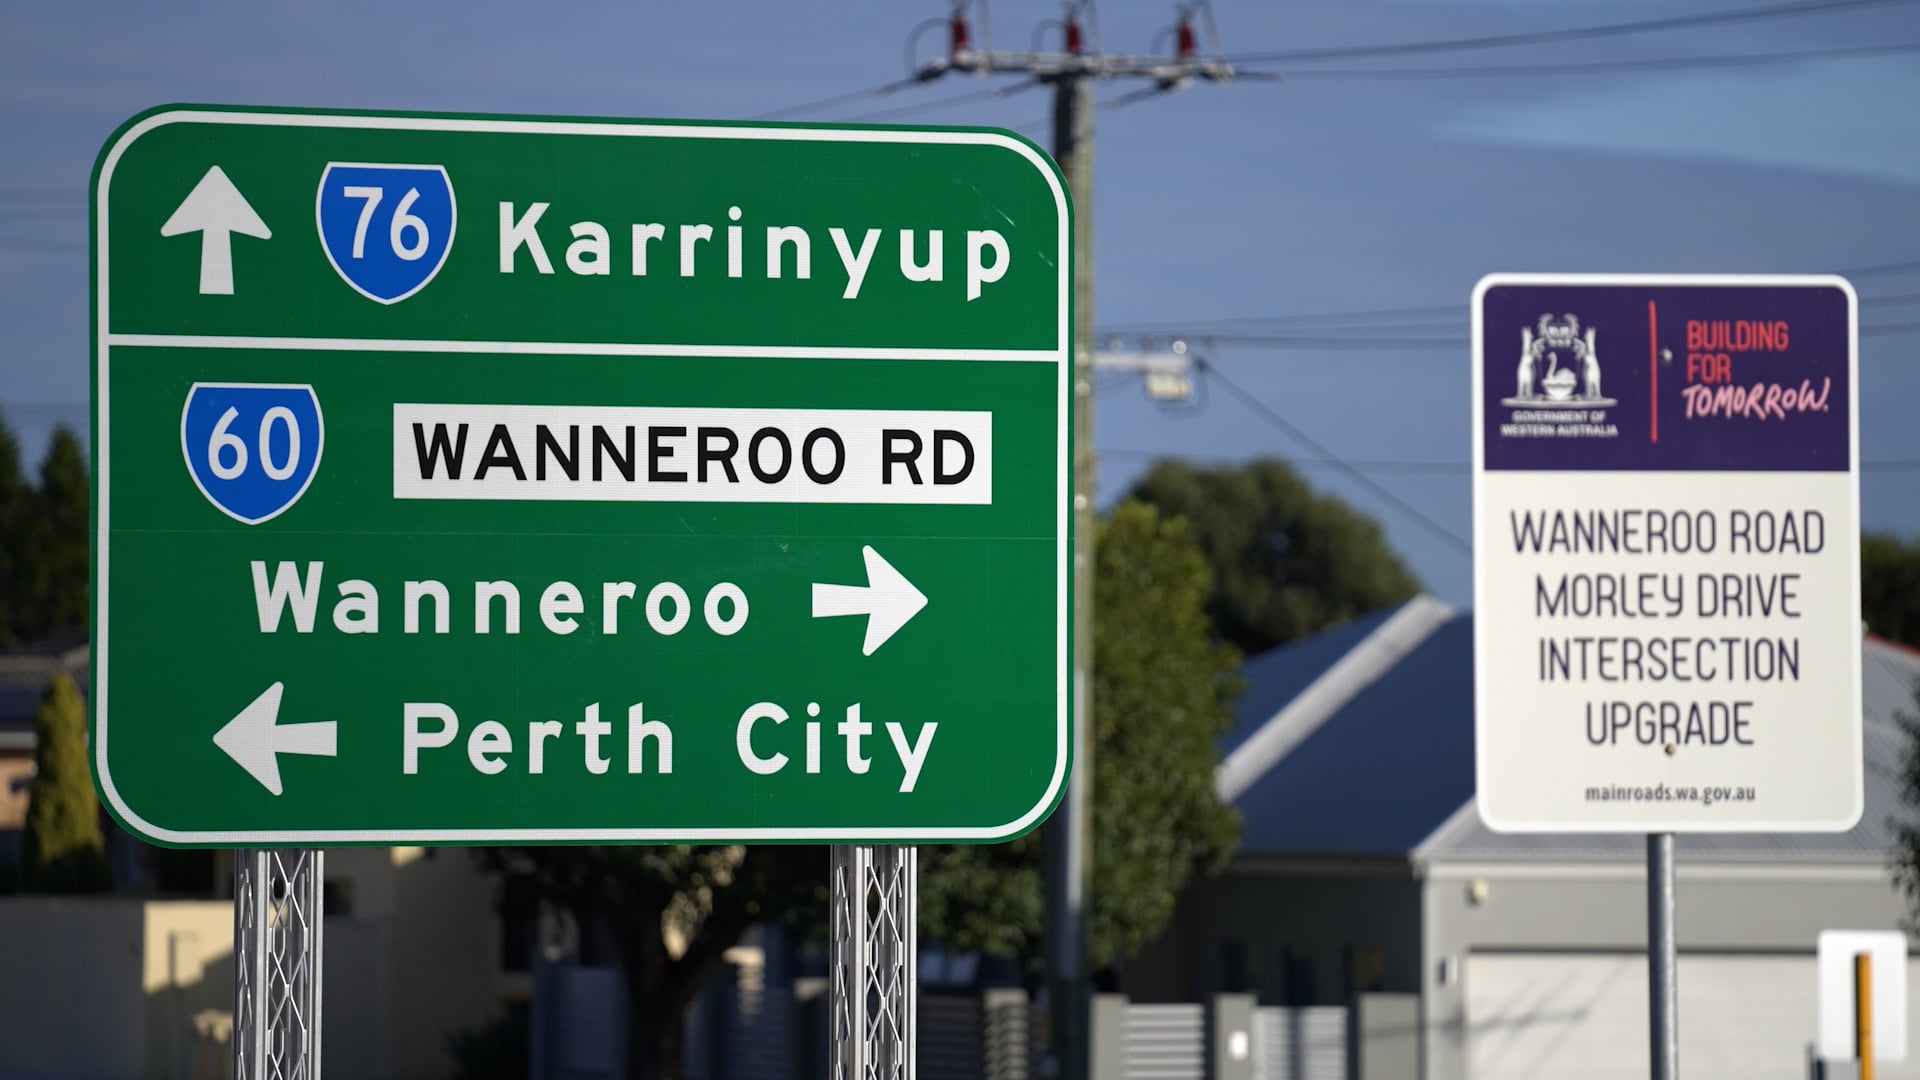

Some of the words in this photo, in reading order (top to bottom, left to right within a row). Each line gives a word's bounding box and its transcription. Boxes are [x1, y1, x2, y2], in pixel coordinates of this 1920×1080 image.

[343, 186, 430, 261] 76
[500, 202, 1012, 301] Karrinyup
[1687, 320, 1789, 351] BUILDING
[1687, 353, 1731, 383] FOR
[1500, 424, 1556, 438] WESTERN
[1557, 424, 1619, 438] AUSTRALIA
[1512, 410, 1588, 423] GOVERNMENT
[1590, 410, 1606, 423] OF
[207, 406, 301, 481] 60
[412, 423, 845, 484] WANNEROO
[882, 429, 974, 485] RD
[1511, 510, 1716, 554] WANNEROO
[1730, 510, 1825, 554] ROAD
[251, 561, 749, 635] Wanneroo
[1536, 574, 1683, 617] MORLEY
[1697, 574, 1801, 618] DRIVE
[1540, 637, 1799, 681] INTERSECTION
[1586, 701, 1754, 745] UPGRADE
[404, 703, 672, 774] Perth
[737, 702, 938, 792] City
[1585, 783, 1756, 805] mainroads.wa.gov.au
